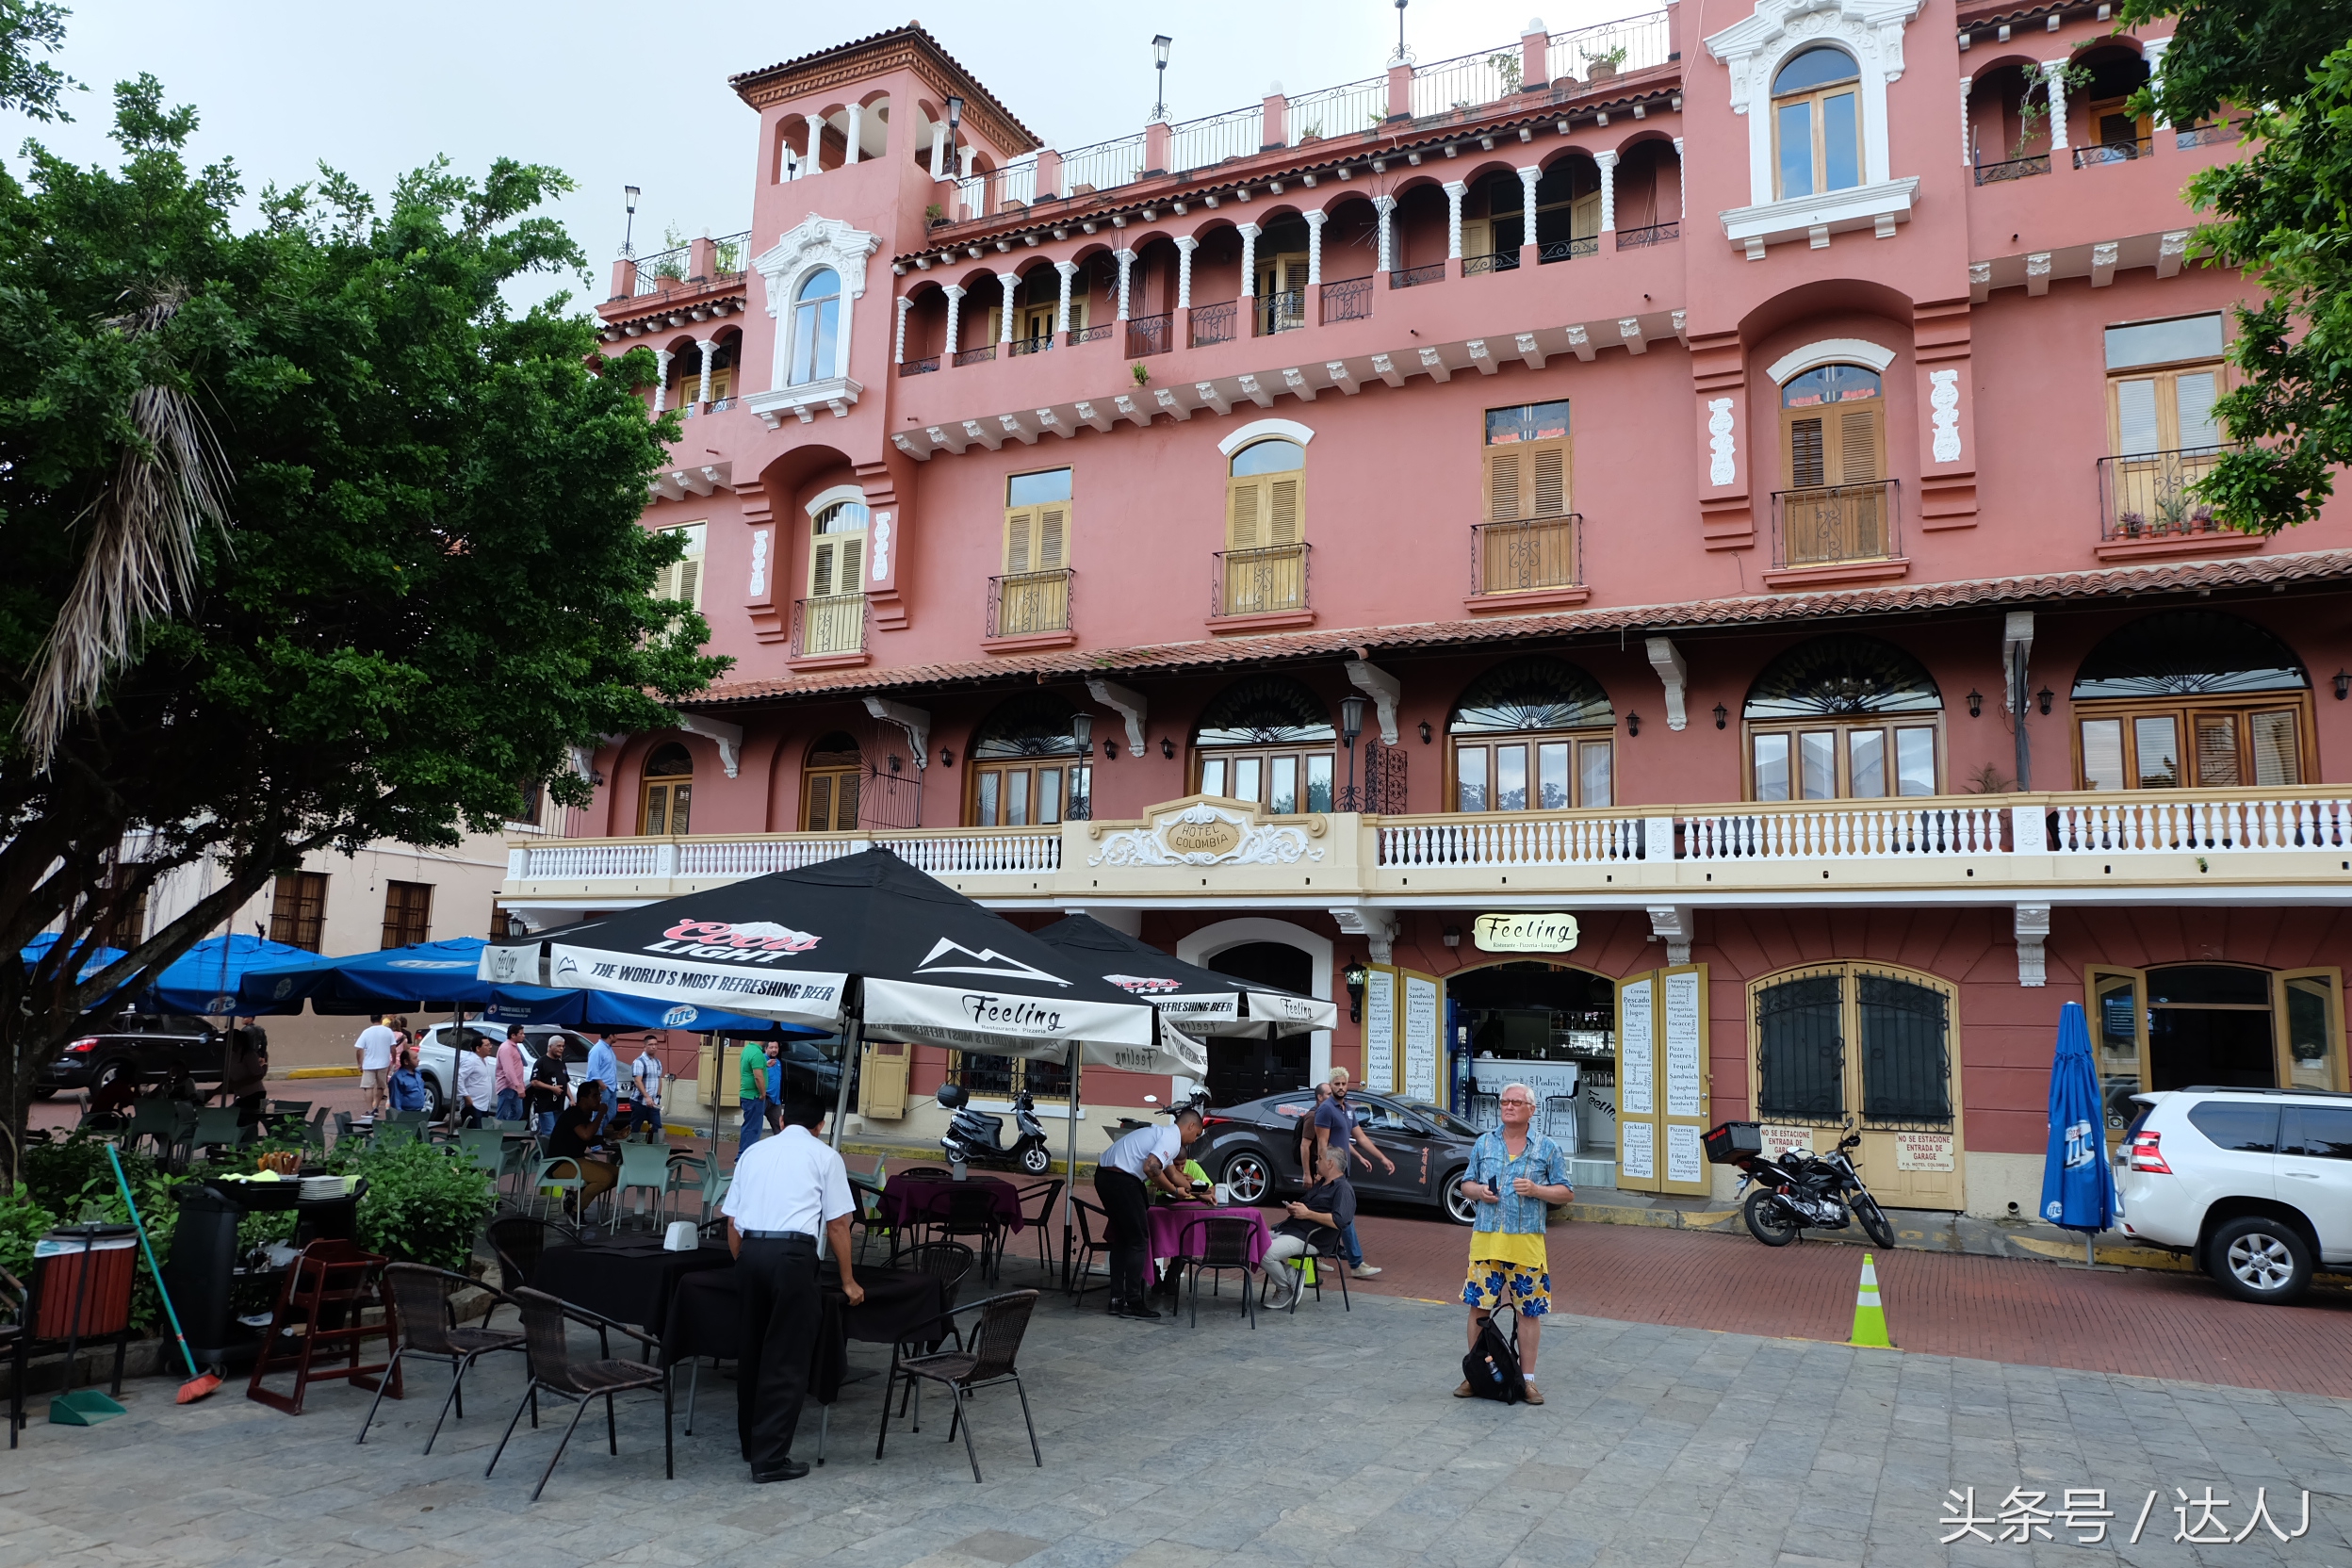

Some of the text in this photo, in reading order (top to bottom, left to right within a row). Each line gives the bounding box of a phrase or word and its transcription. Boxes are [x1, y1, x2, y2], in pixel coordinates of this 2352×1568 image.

[1182, 825, 1219, 837] HOTEL
[1176, 833, 1229, 848] COLOMBIA
[662, 918, 823, 952] Coors
[1478, 917, 1574, 942] Feeling
[643, 939, 798, 963] LIGHT
[591, 962, 836, 1001] THE WORLD'S MOST REFRESHING BEER
[962, 994, 1066, 1031] Feeling
[1156, 1002, 1233, 1012] REFRESHING BEER
[1280, 998, 1314, 1020] Feeling
[665, 1009, 694, 1027] Lite
[1536, 1075, 1560, 1086] Postres
[1779, 1130, 1810, 1138] ESTACIONE
[1898, 1135, 1907, 1143] NO
[1918, 1135, 1951, 1144] ESTACIONE
[1768, 1137, 1794, 1146] ENTRADA
[1906, 1144, 1932, 1152] ENTRADA
[1913, 1152, 1937, 1161] GARAGE
